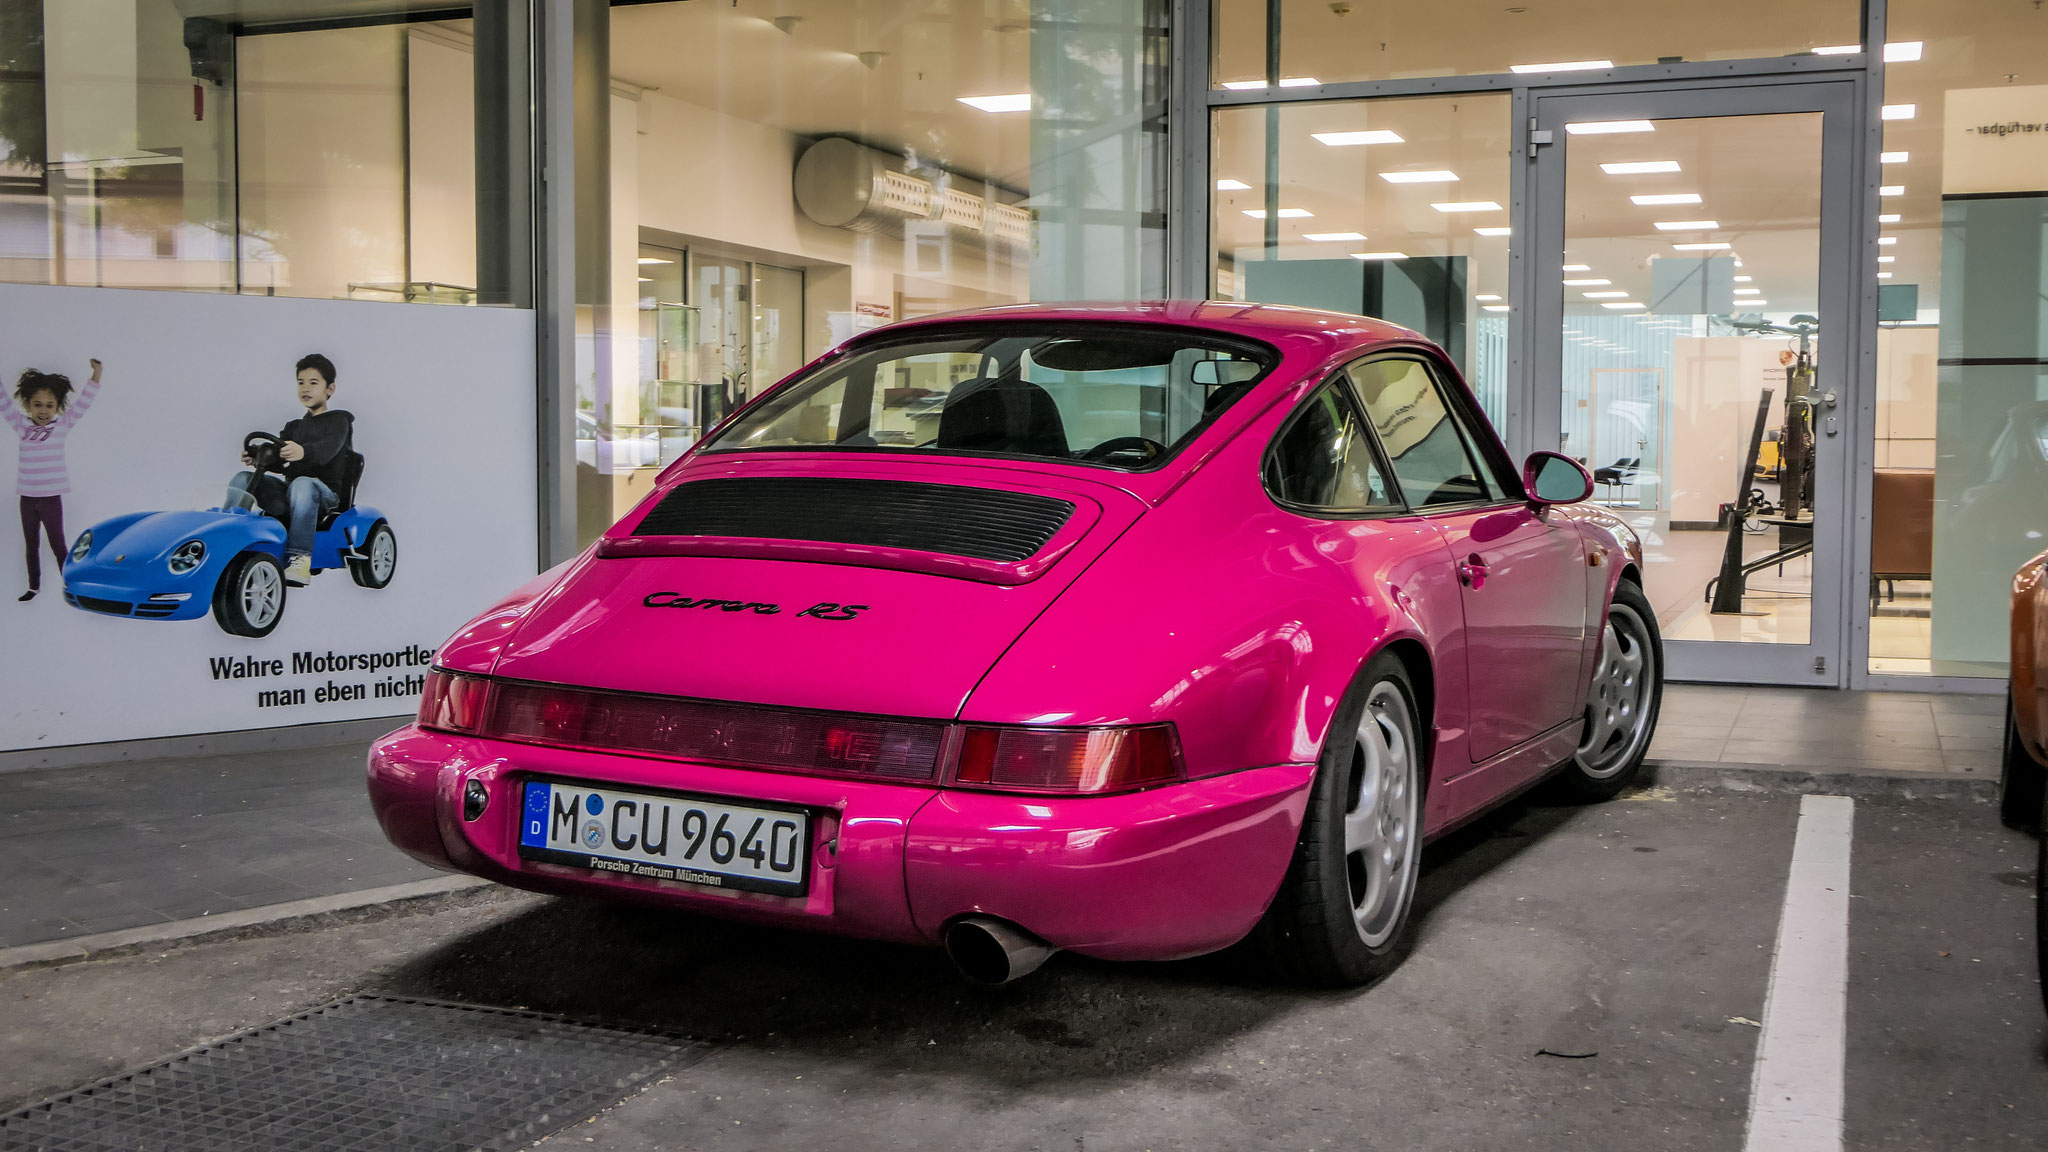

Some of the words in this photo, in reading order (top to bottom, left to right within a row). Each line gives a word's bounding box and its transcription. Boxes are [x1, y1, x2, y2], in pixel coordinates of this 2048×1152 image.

[643, 592, 782, 615] Carrera
[796, 602, 871, 620] RS
[210, 655, 284, 680] Wahre
[258, 687, 306, 708] man
[314, 680, 366, 703] eben
[374, 674, 425, 699] nicht
[531, 820, 541, 835] D
[552, 792, 580, 844] M
[682, 808, 799, 873] 9640
[590, 856, 630, 872] Porsche
[632, 863, 674, 879] Zentrum
[675, 868, 722, 885] München
